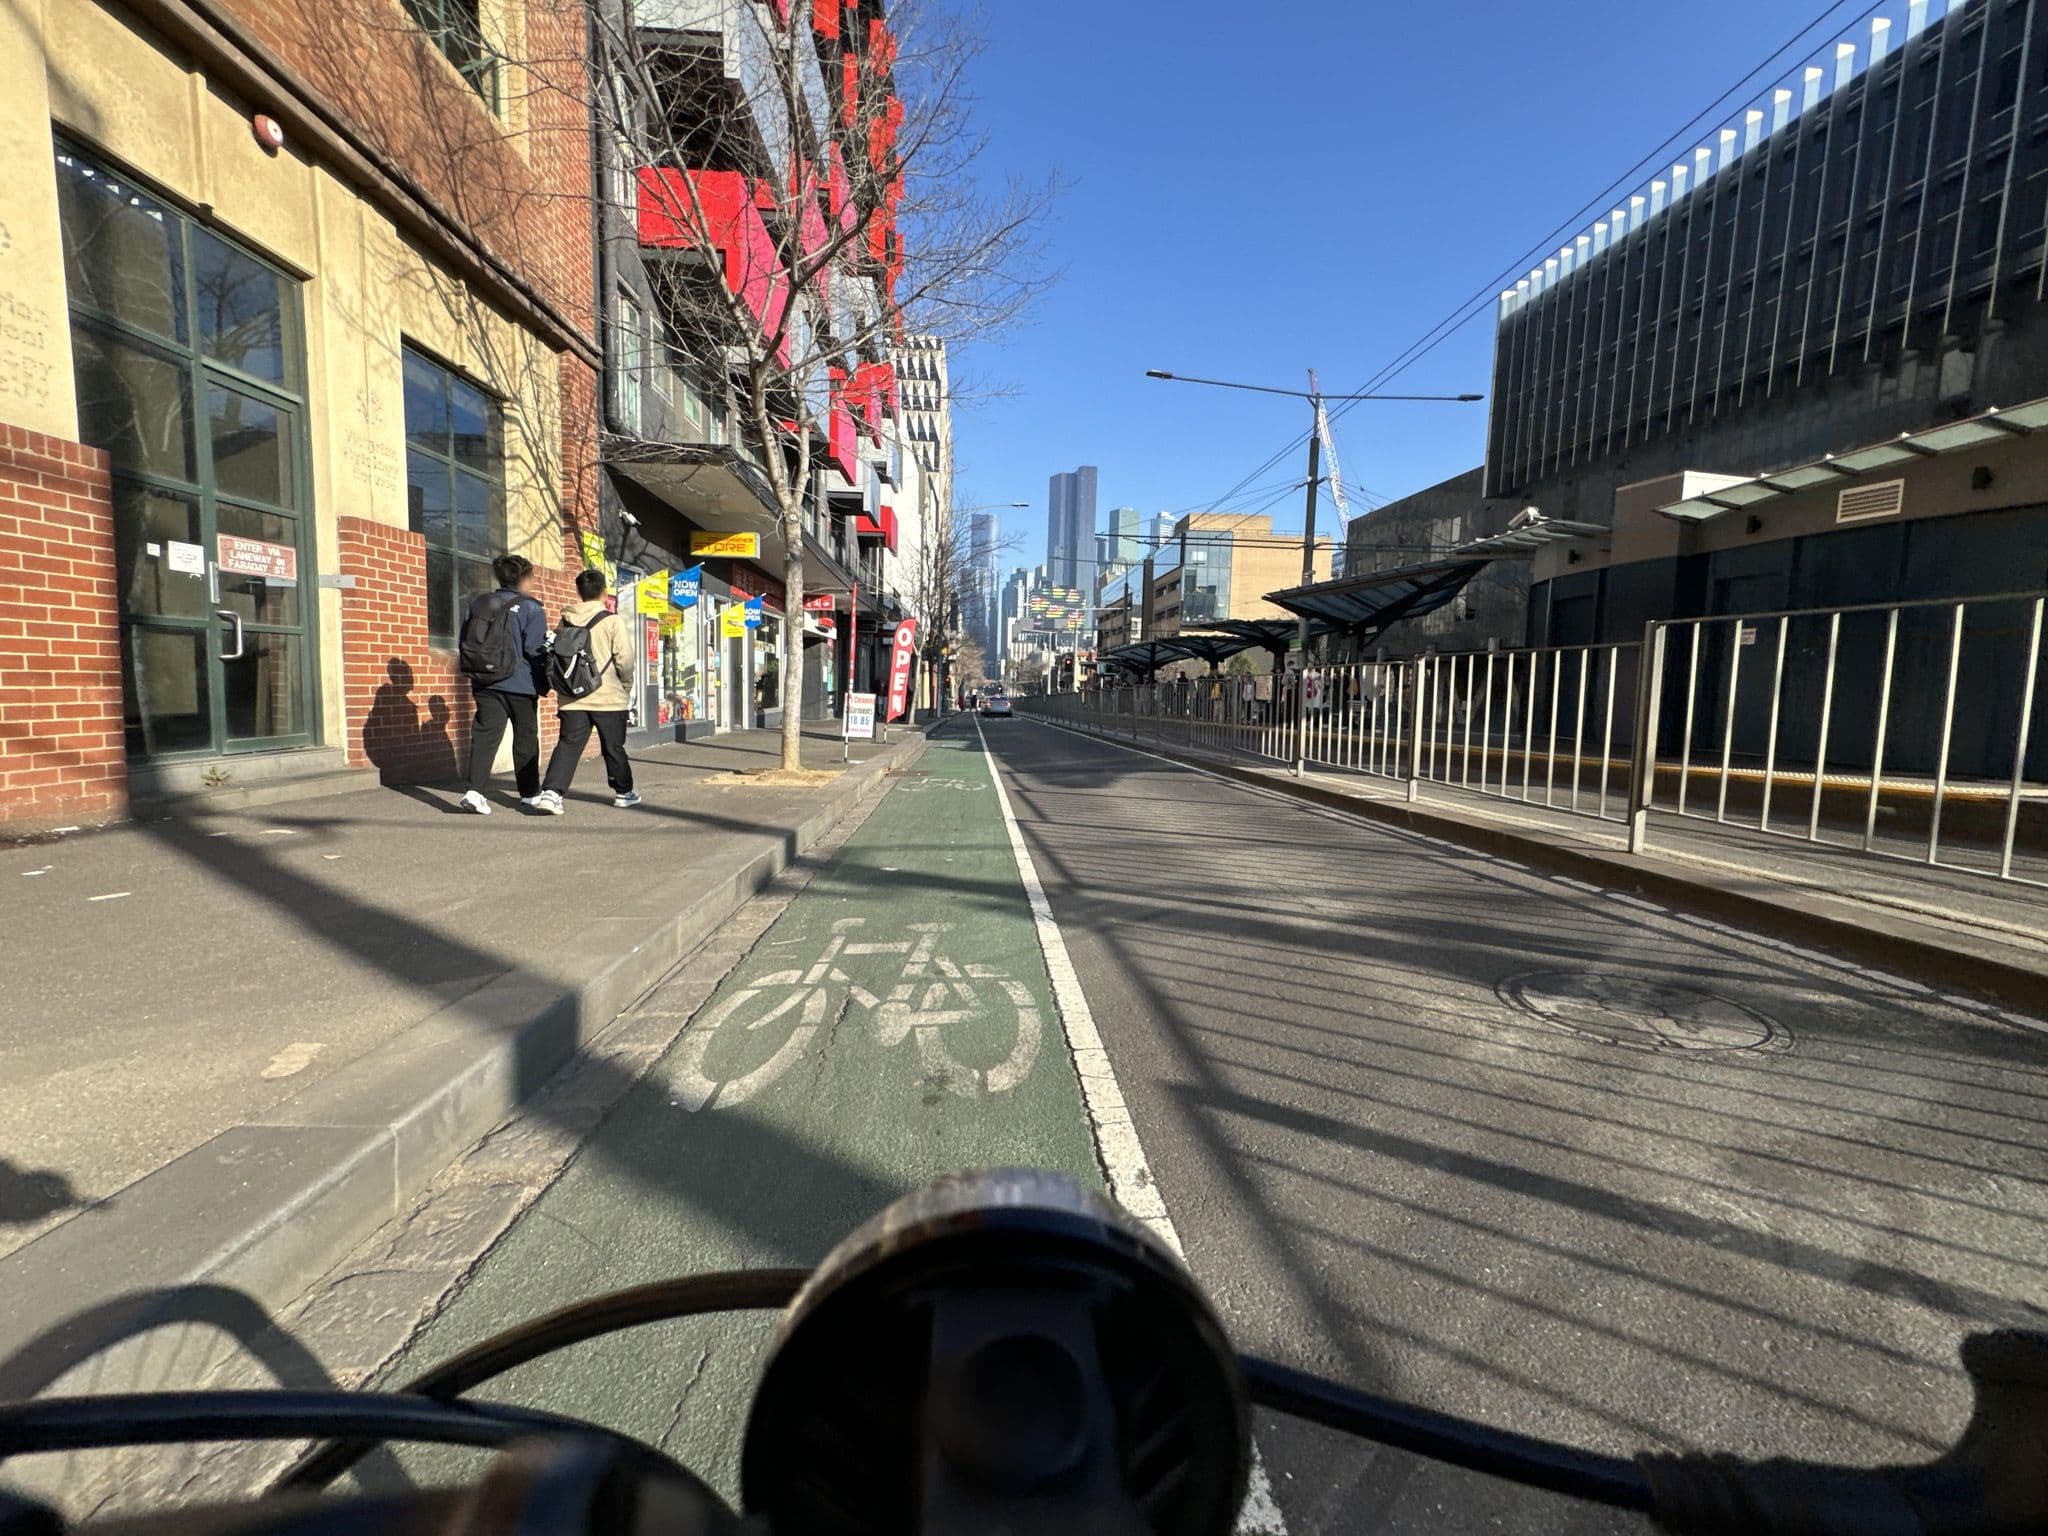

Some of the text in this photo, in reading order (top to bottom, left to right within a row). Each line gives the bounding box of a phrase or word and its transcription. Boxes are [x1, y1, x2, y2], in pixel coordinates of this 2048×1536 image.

[234, 541, 281, 557] ENTER VIA
[695, 542, 746, 553] STORE
[230, 550, 271, 564] LANEWAY
[228, 559, 268, 572] FARADAY
[674, 580, 698, 589] NOW
[674, 589, 698, 598] OPEN
[892, 627, 913, 713] OPEN
